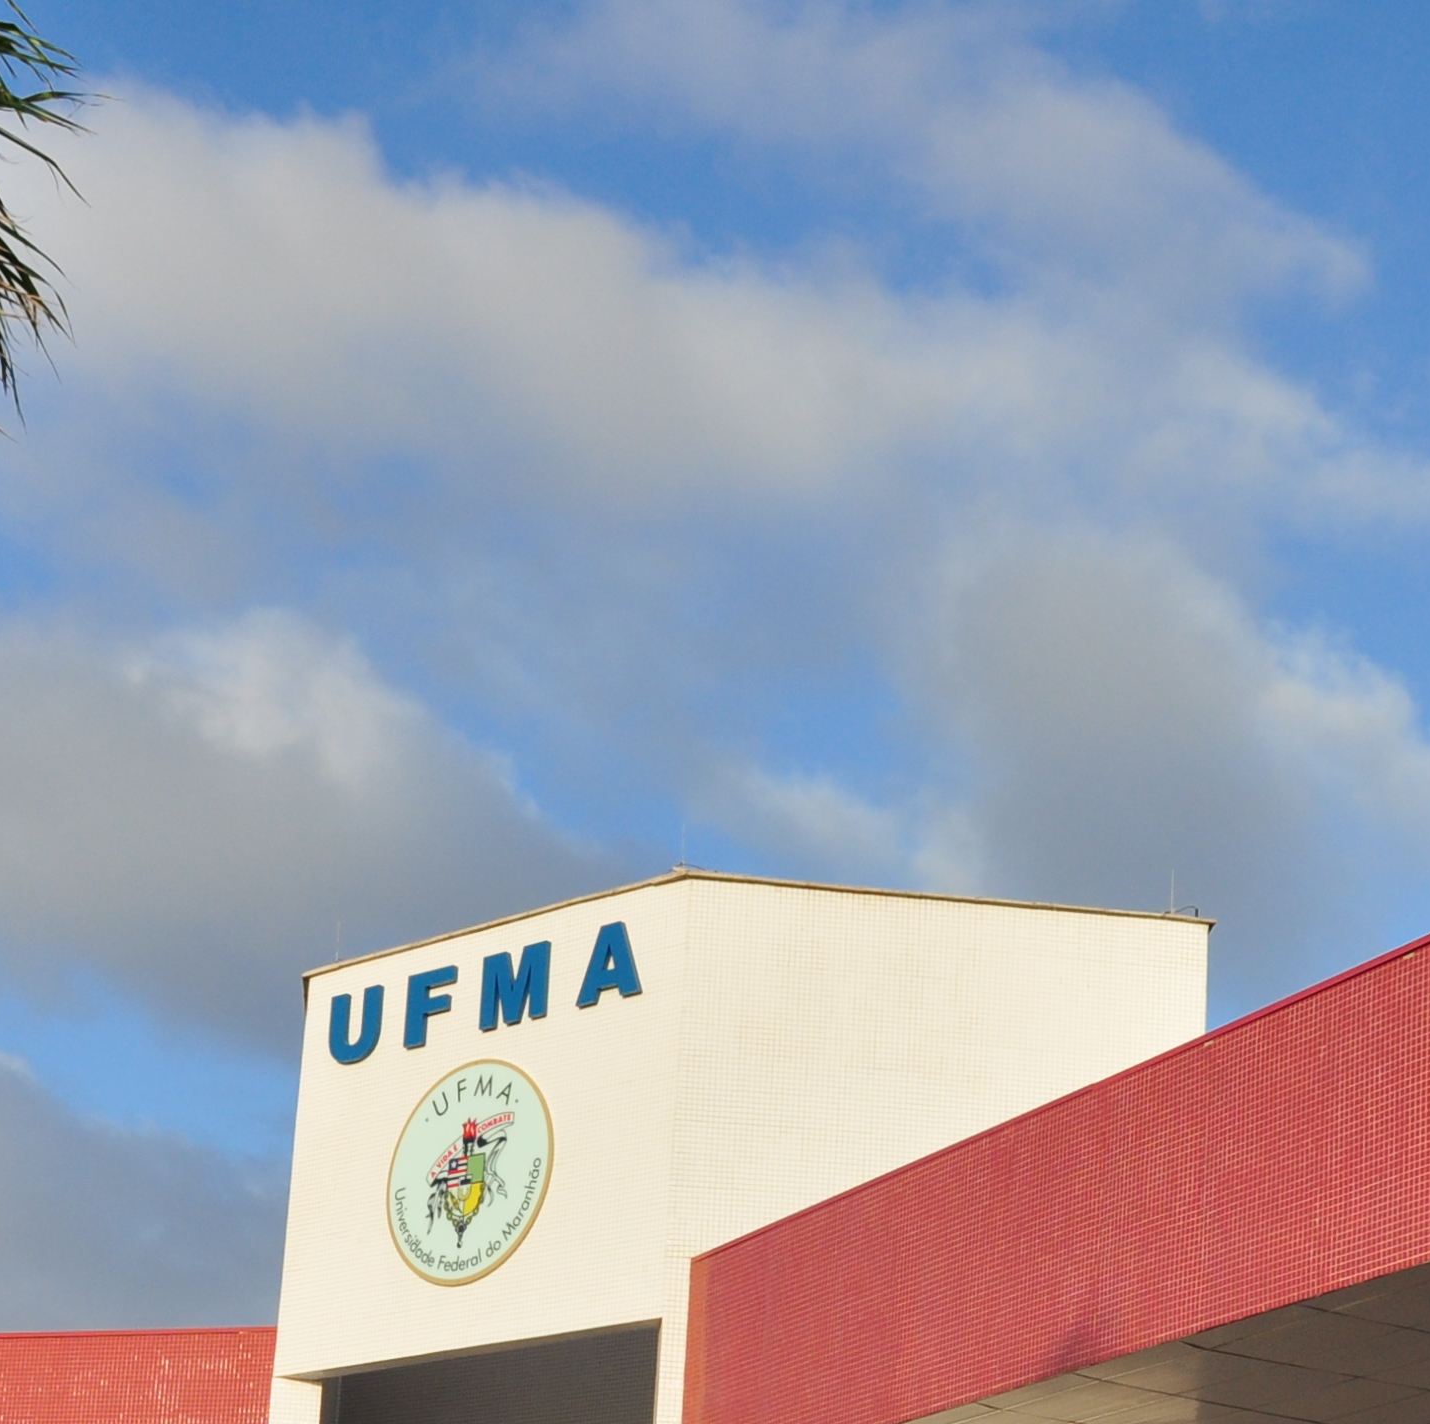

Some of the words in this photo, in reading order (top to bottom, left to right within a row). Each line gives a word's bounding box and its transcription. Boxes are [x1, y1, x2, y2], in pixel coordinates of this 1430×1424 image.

[329, 921, 643, 1065] UFMA
[432, 1074, 512, 1116] UFMA
[436, 1150, 453, 1169] VIDA
[477, 1113, 511, 1134] COMBATE
[394, 1187, 435, 1267] Universidade
[437, 1248, 482, 1272] Federal
[486, 1240, 502, 1258] do
[502, 1157, 542, 1241] Maranhão
